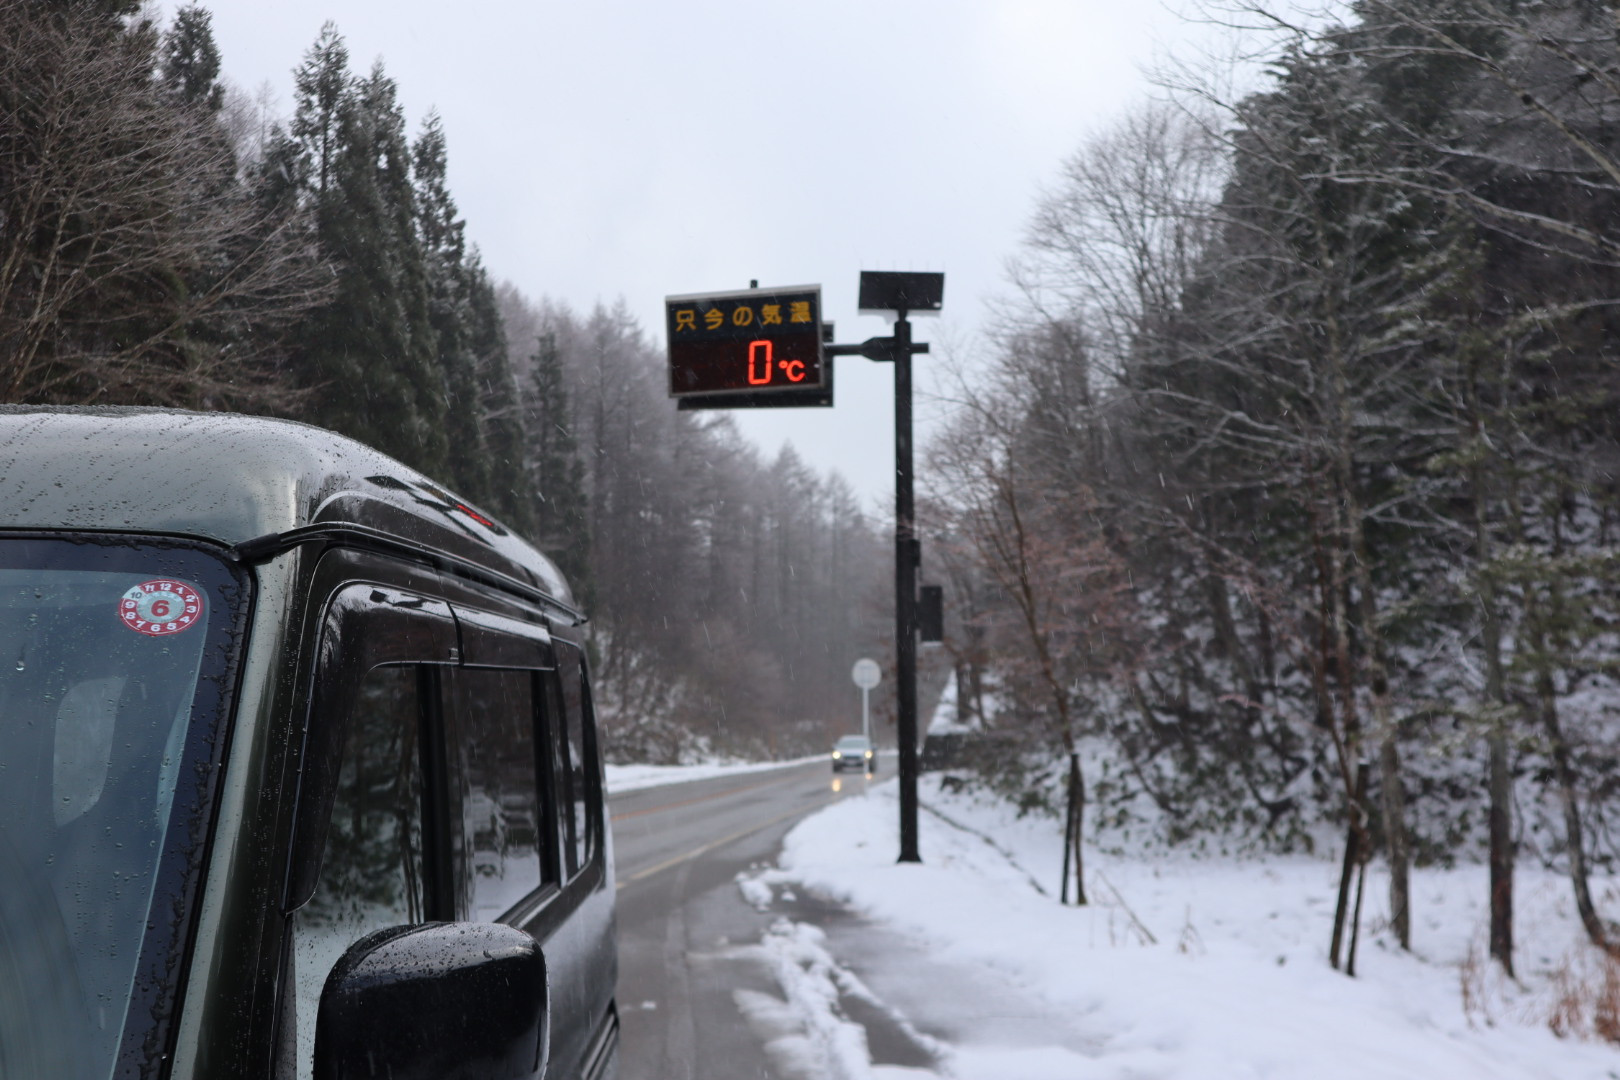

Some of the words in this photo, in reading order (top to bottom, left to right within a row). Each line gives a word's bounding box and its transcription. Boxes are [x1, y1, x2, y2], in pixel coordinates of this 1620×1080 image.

[160, 583, 171, 591] 12
[151, 600, 170, 616] 6
[187, 605, 196, 613] 3
[136, 620, 146, 628] 7
[151, 624, 160, 632] 6
